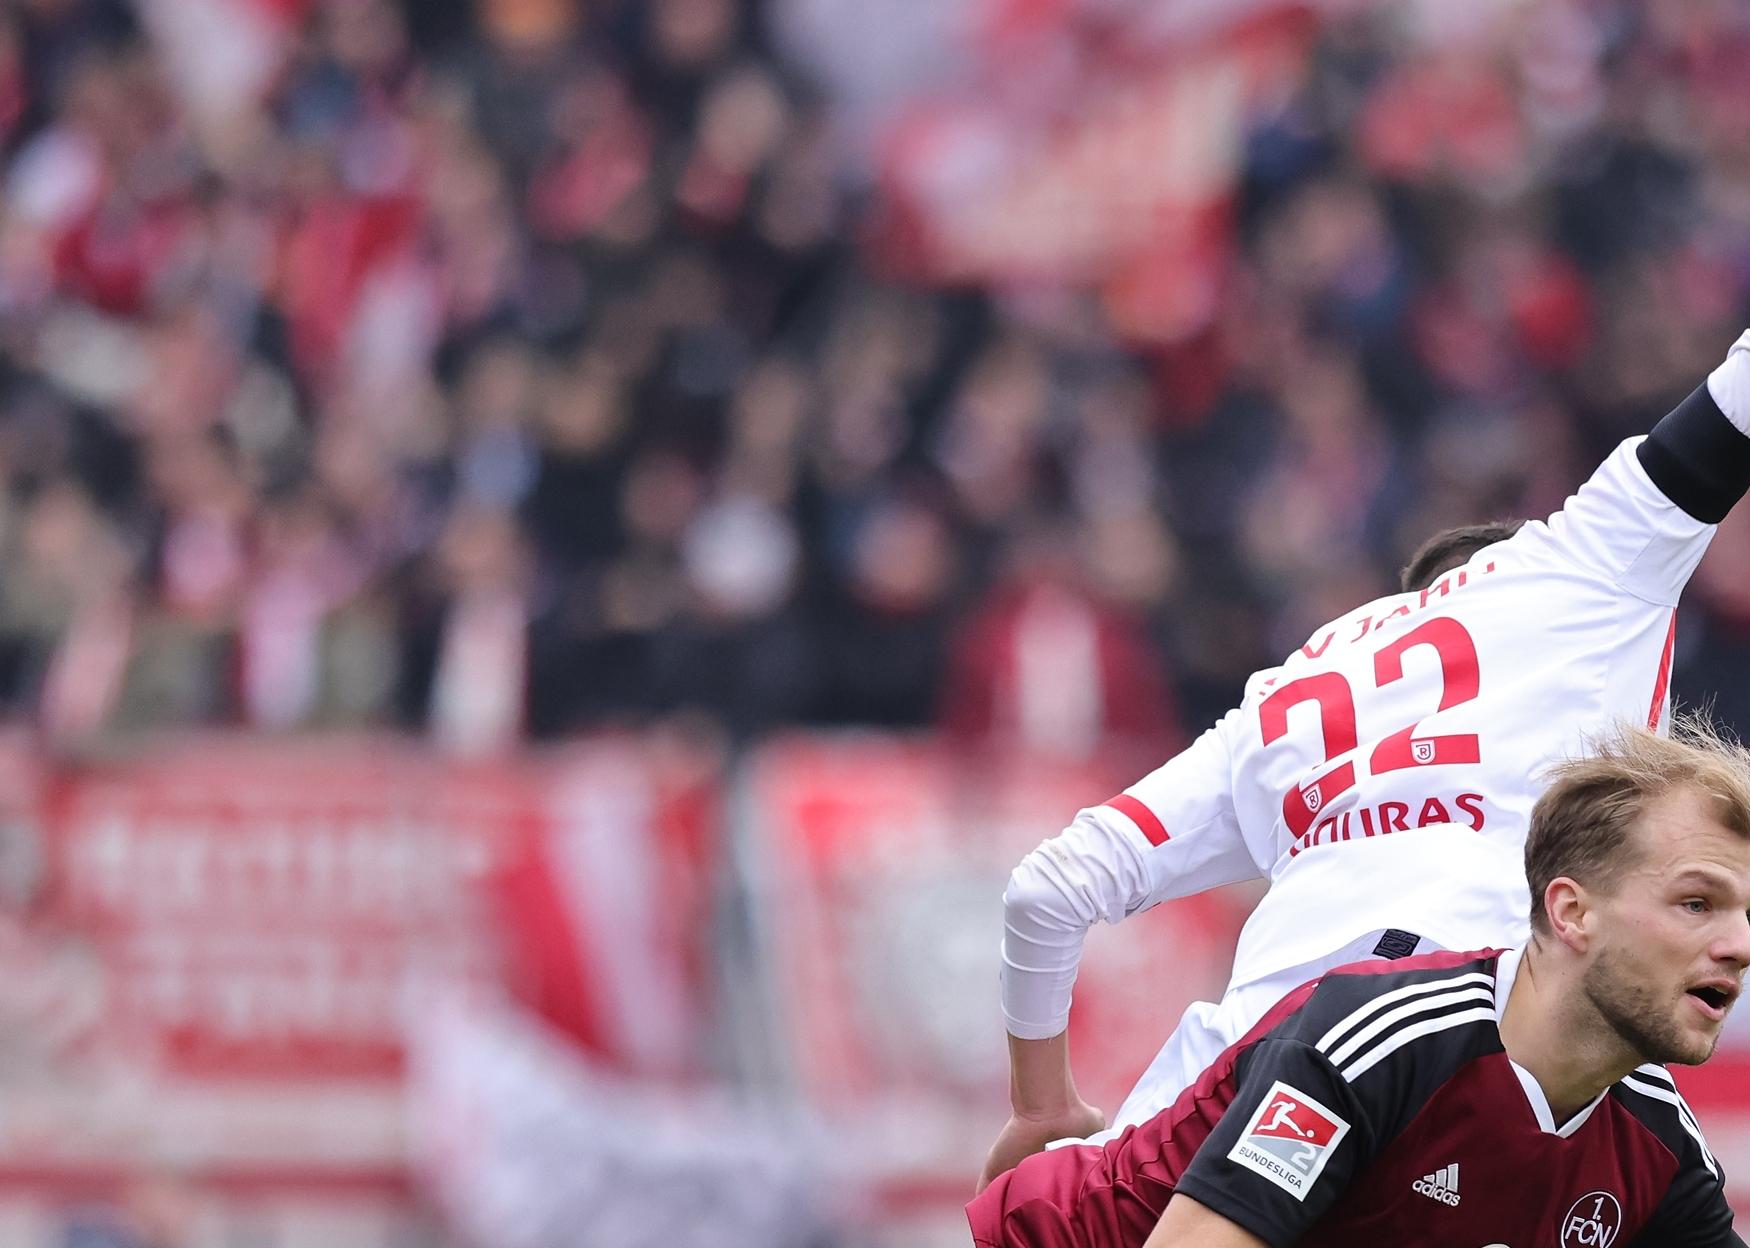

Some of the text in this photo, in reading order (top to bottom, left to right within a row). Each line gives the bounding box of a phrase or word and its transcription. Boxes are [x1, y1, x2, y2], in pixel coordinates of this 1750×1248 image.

[1259, 617, 1481, 840] 22
[1290, 793, 1485, 857] OURAS
[1239, 1146, 1303, 1190] BUNDESLIGA
[1412, 1179, 1461, 1207] adidas
